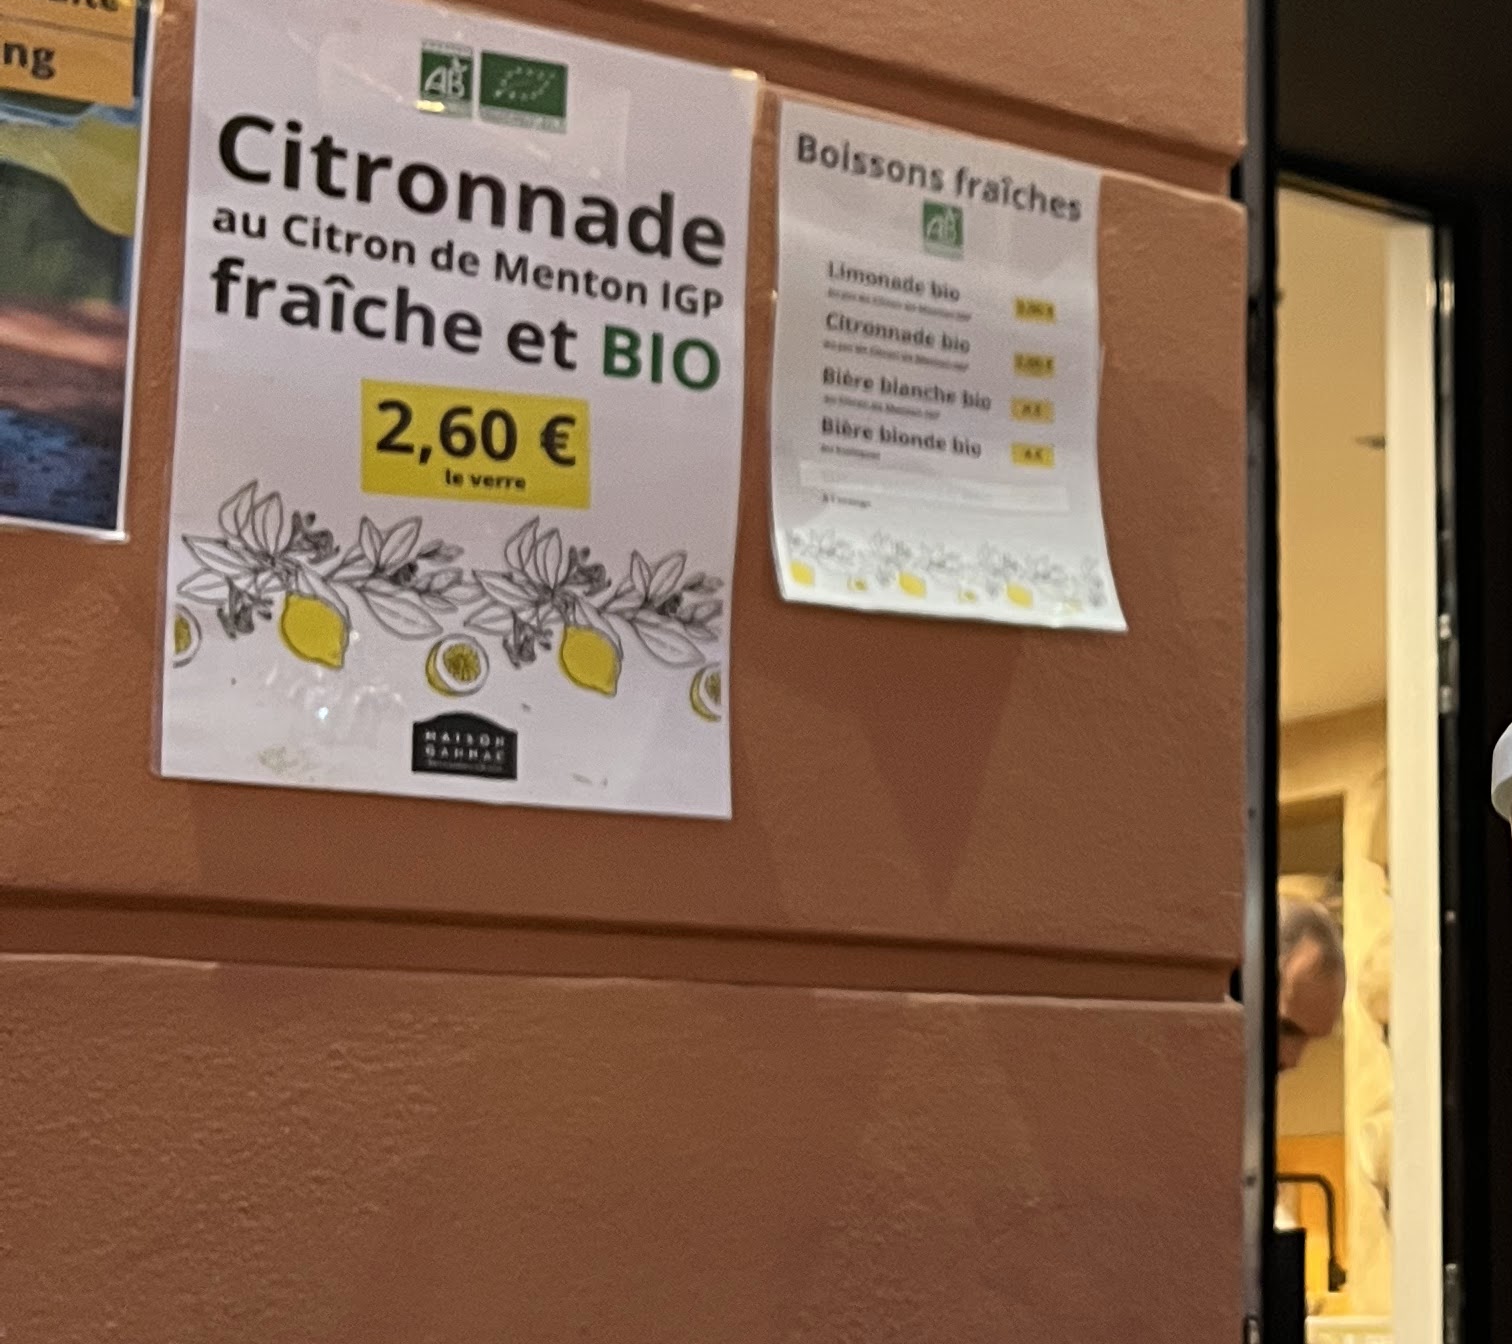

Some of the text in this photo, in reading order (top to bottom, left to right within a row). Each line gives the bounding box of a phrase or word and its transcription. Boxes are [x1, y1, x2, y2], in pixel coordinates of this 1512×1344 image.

[219, 113, 727, 268] Citronnade
[797, 131, 1083, 223] Boissons fraîches
[213, 207, 725, 319] au Citron de Menton IGP
[828, 260, 961, 303] Limonade bio
[210, 256, 722, 392] fraîche et BIO
[826, 311, 972, 355] Citronnade bio
[822, 365, 875, 391] Bière
[881, 376, 957, 405] blanche
[961, 389, 993, 412] bio
[375, 398, 577, 469] 2,60 €
[821, 415, 874, 442] Bière
[879, 424, 948, 453] blonde
[952, 435, 983, 459] bio
[444, 467, 527, 492] le verre
